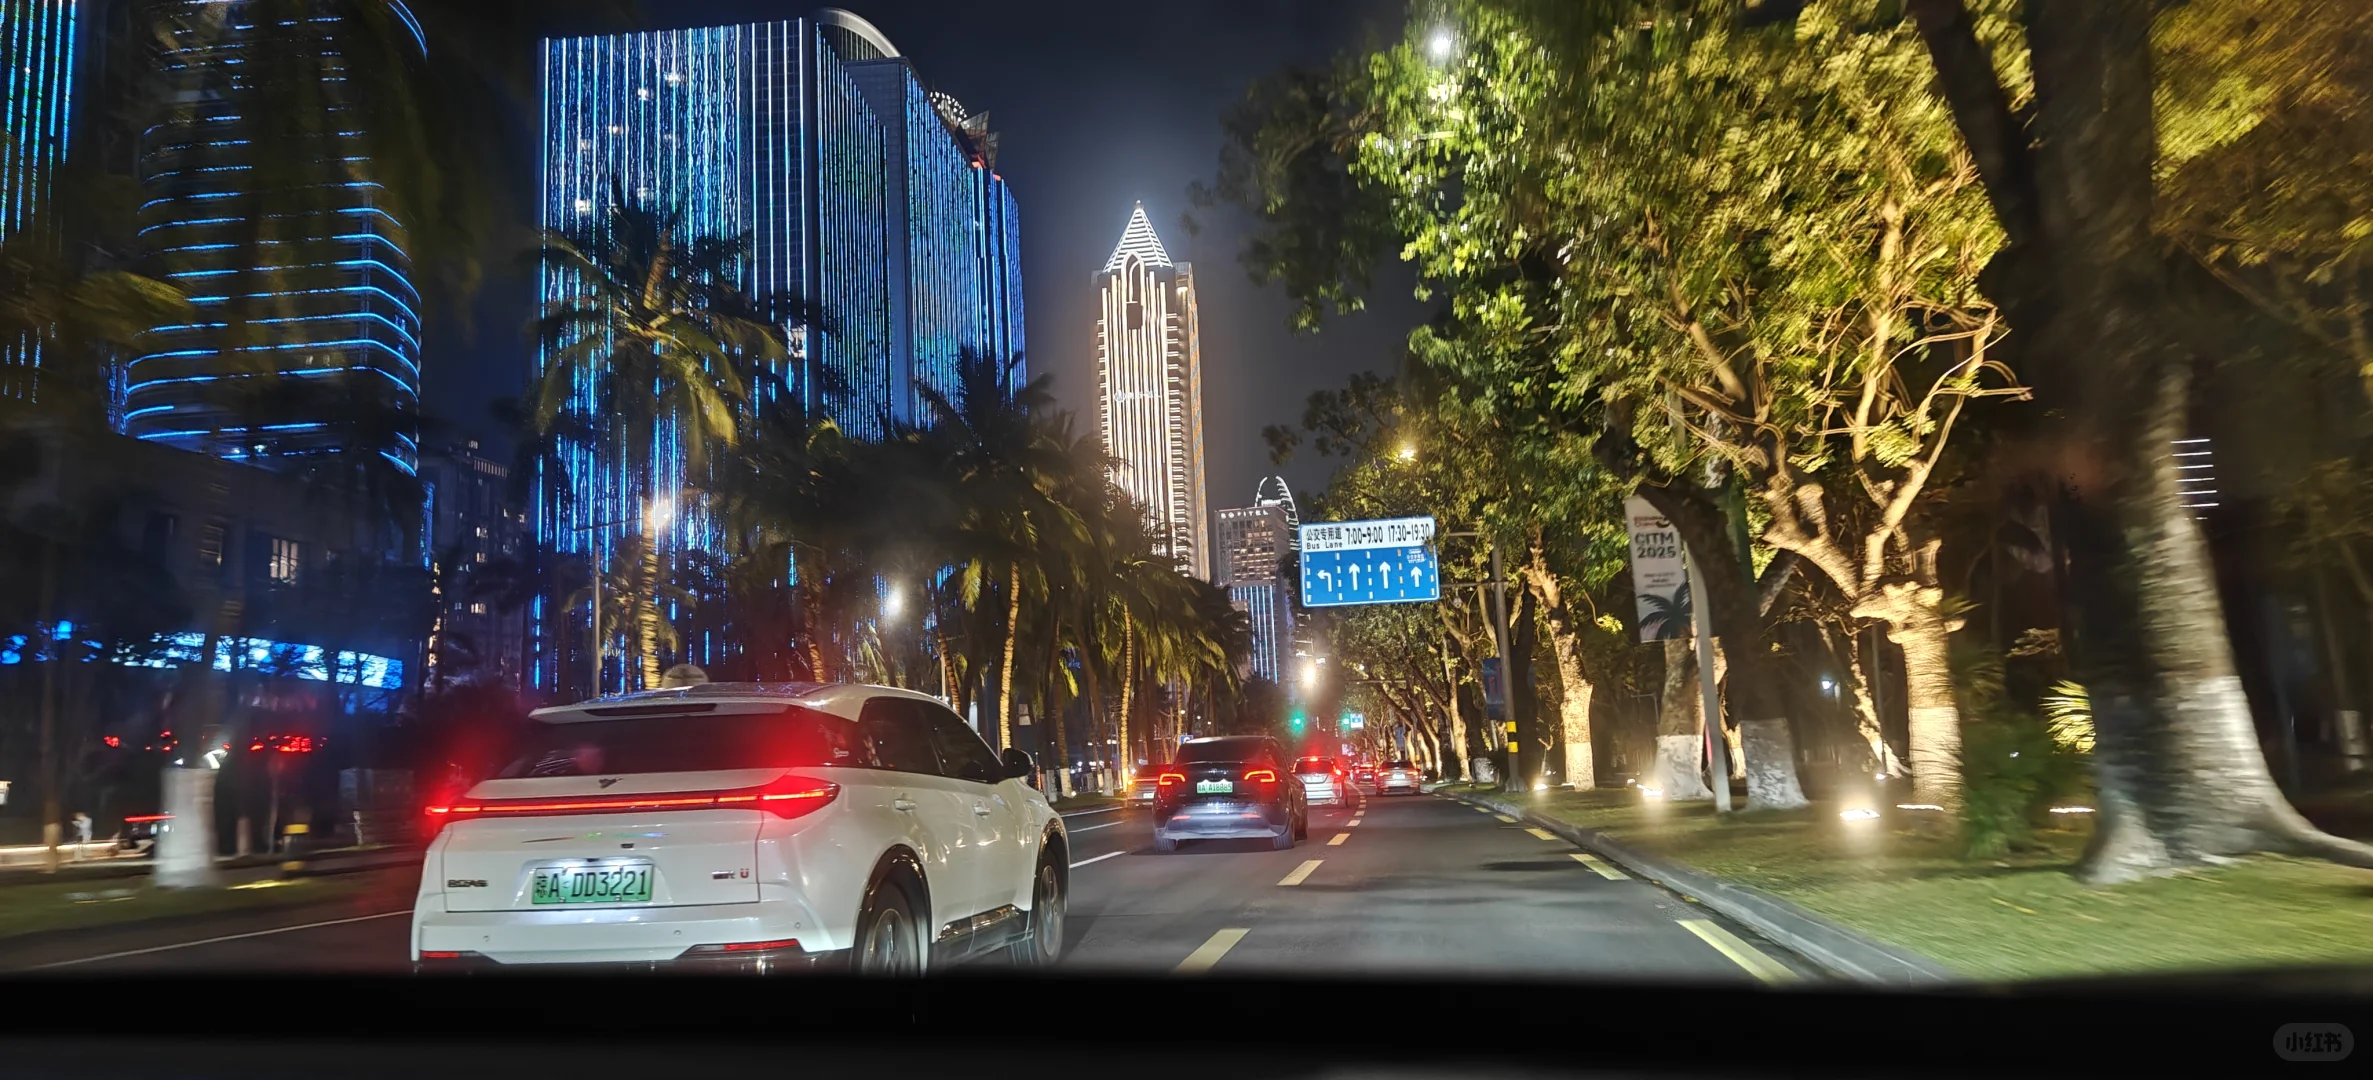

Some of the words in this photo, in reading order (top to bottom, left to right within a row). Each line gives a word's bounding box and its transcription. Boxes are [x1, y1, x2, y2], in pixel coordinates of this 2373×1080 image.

[1306, 527, 1343, 541] 公交专用道
[1345, 526, 1384, 545] 7:00-9:00
[1388, 523, 1430, 543] 17:30-19:30
[1635, 531, 1674, 545] CITM
[1306, 542, 1321, 550] Bus
[1325, 541, 1343, 549] Lane
[1637, 545, 1676, 559] 2025
